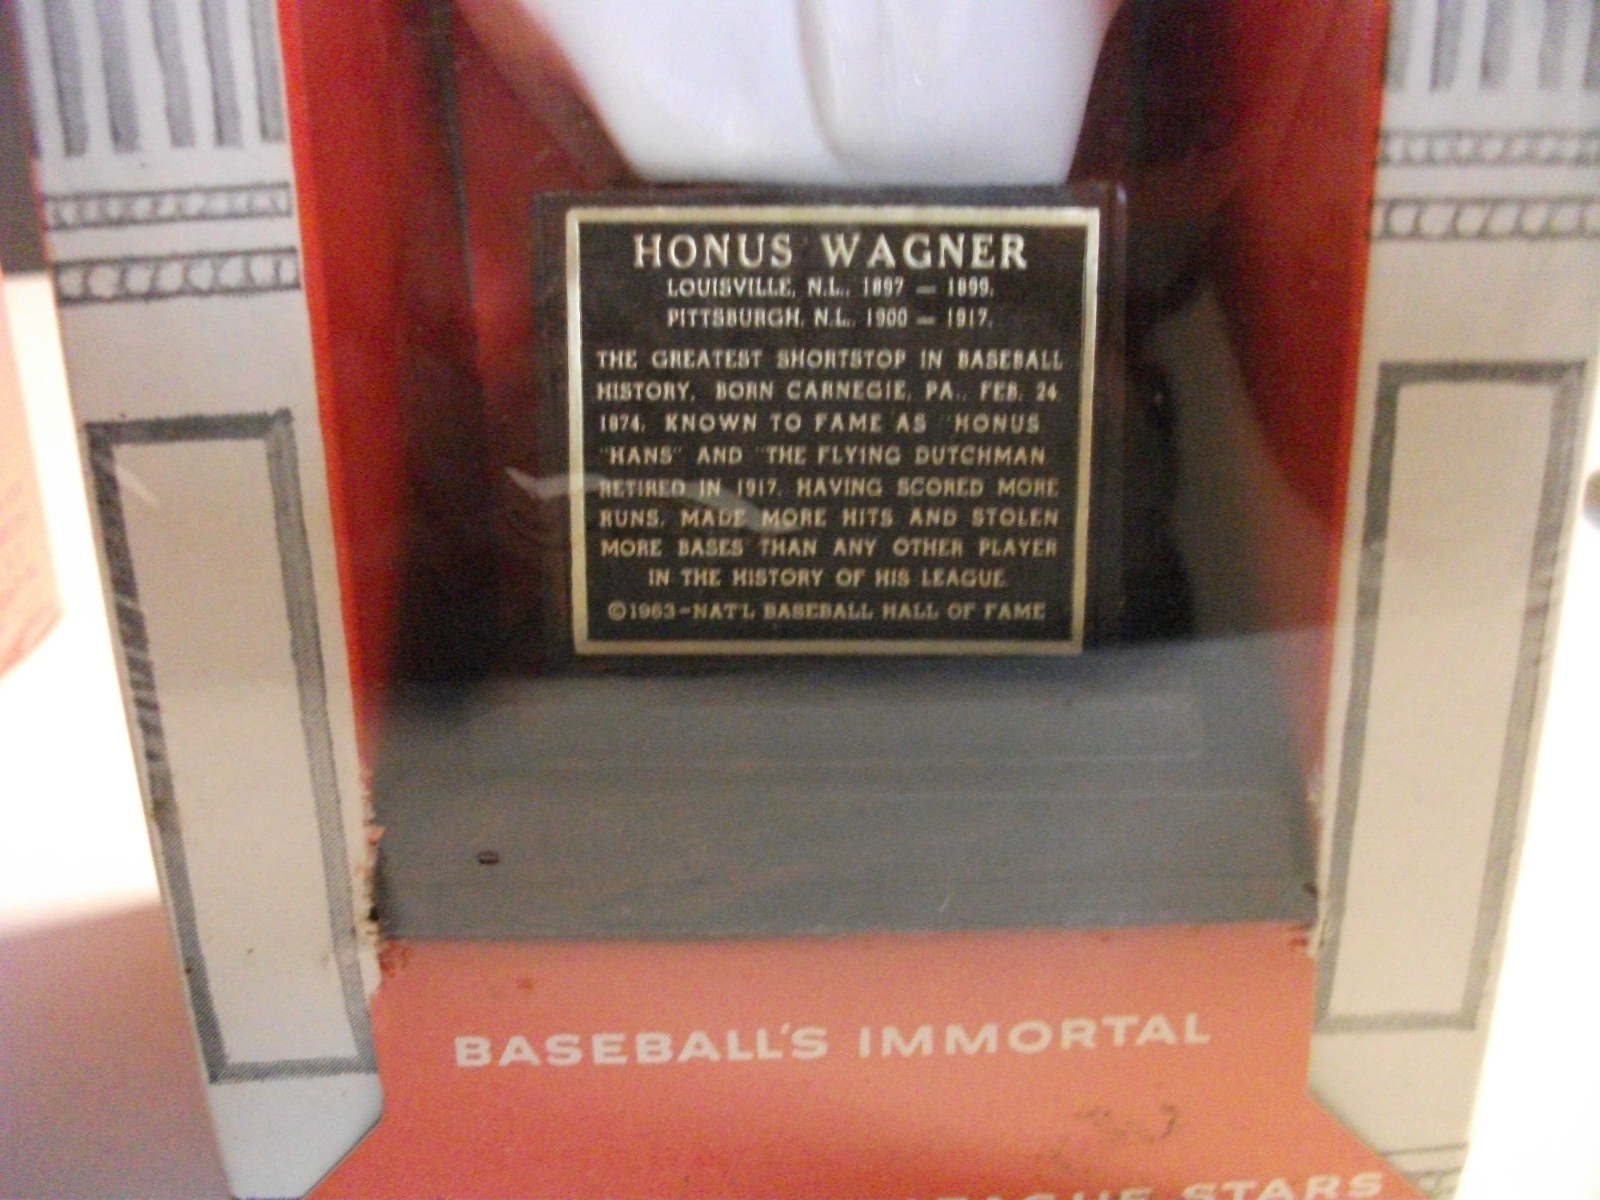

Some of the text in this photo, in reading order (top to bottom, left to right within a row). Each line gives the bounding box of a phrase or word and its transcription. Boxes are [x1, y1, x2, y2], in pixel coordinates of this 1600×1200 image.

[632, 232, 1028, 270] HONUS WAGNER
[597, 349, 1064, 370] THE GREATEST SHORTSTOP IN BASEBALL
[716, 380, 773, 401] BORN
[664, 412, 757, 433] KNOWN
[769, 412, 802, 433] TO
[814, 412, 882, 433] FAME
[896, 412, 927, 433] AS
[697, 445, 743, 465] AND
[816, 445, 901, 466] FLYING
[599, 477, 686, 497] RETIRED
[700, 477, 721, 497] IN
[796, 476, 882, 498] HAVING
[896, 476, 985, 498] SCORED
[997, 476, 1060, 498] MORE
[681, 508, 748, 528] MADE
[762, 507, 827, 528] MORE
[841, 507, 894, 528] HITS
[908, 507, 958, 528] AND
[971, 507, 1059, 528] STOLEN
[600, 536, 1058, 558] MORE BASES THAN ANY OTHER PLAYER
[649, 567, 670, 588] IN
[681, 567, 721, 588] THE
[733, 567, 824, 588] HISTORY
[835, 567, 865, 588] OF
[875, 567, 911, 588] HIS
[764, 601, 873, 622] BASEBALL
[882, 601, 940, 622] HALL
[947, 601, 976, 622] OF
[984, 601, 1047, 622] FAME
[453, 1011, 1212, 1069] BASEBALL'S IMMORTAL
[1182, 1170, 1384, 1200] STARS
